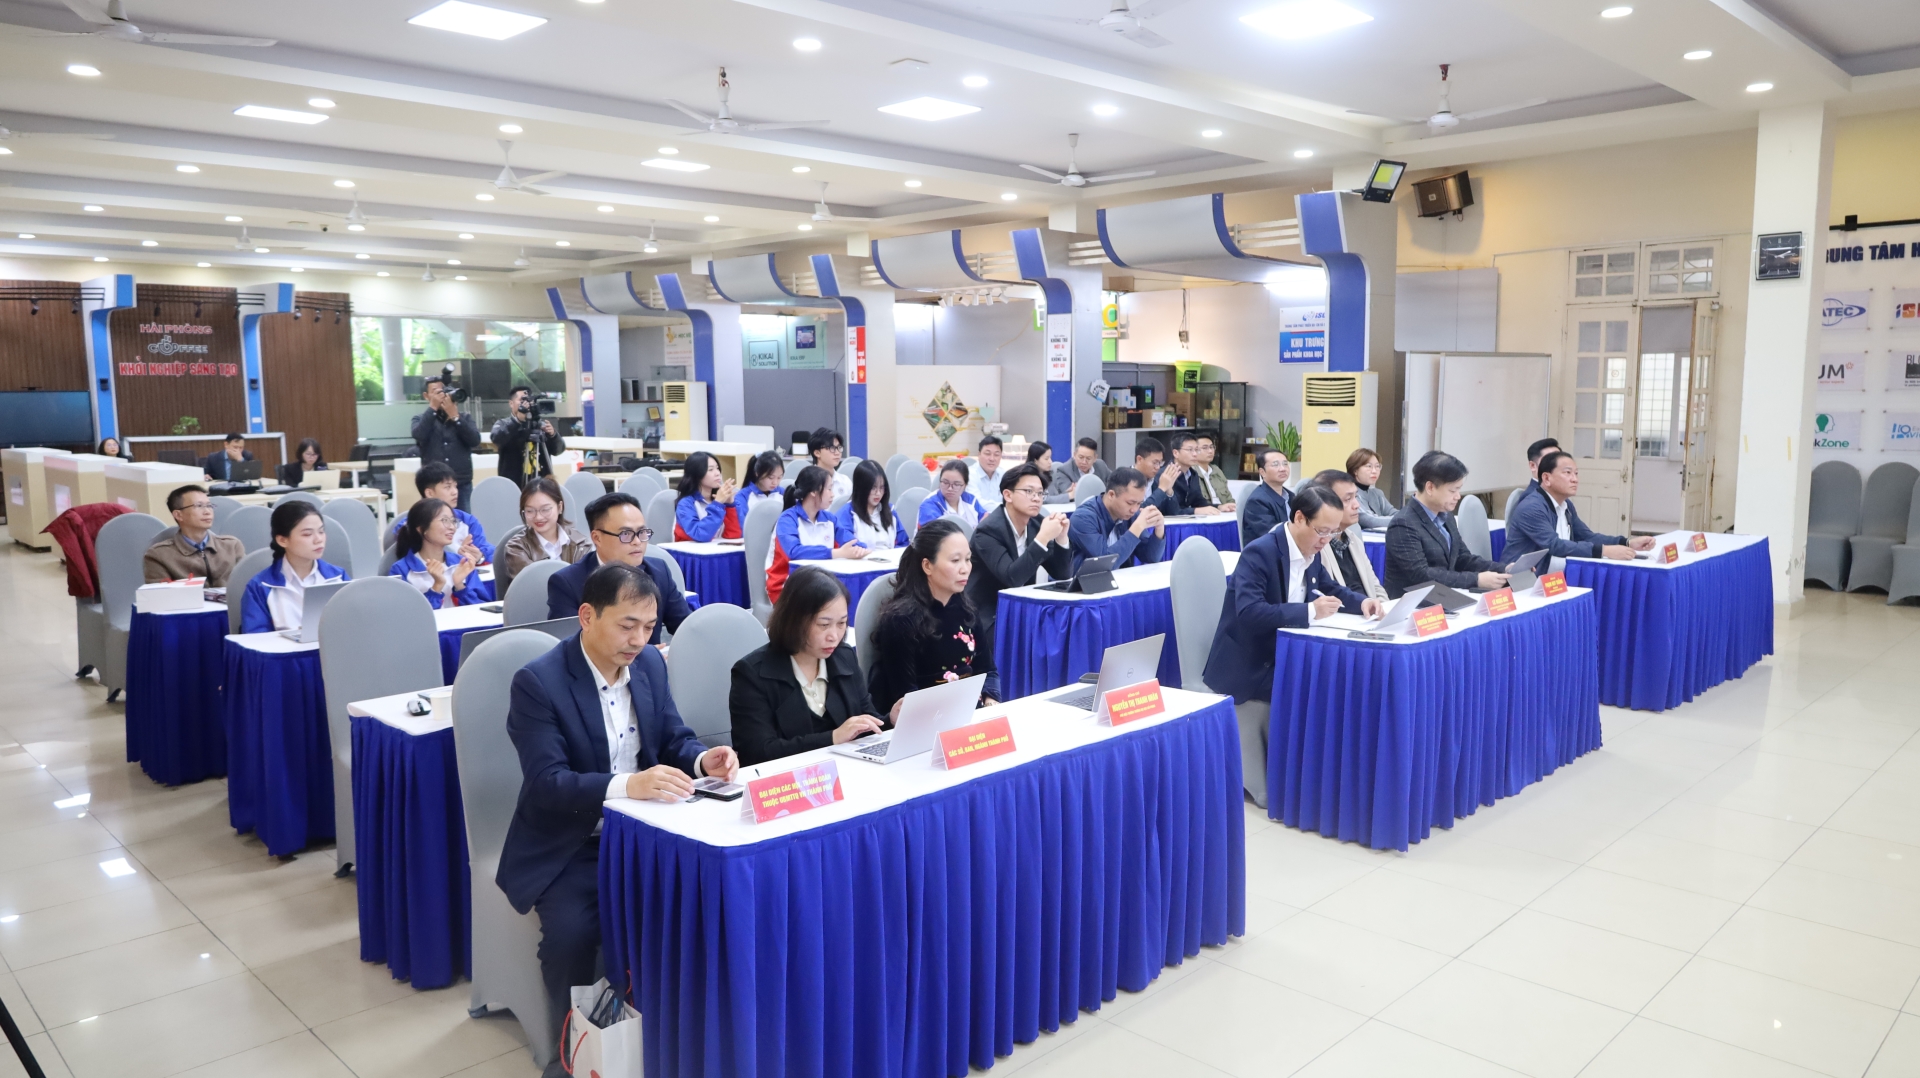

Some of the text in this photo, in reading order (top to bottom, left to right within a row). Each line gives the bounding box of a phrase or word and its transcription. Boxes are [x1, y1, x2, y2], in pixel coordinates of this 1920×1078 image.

[1826, 246, 1863, 263] UNG
[1869, 241, 1905, 260] TÂM
[1291, 338, 1303, 348] KHU
[1906, 354, 1920, 364] BL
[149, 360, 187, 377] NGHIỆP
[190, 358, 216, 375] SÁNG
[218, 363, 238, 377] TẠO
[1814, 438, 1849, 447] kZone
[988, 738, 1001, 746] THÀNH
[1001, 734, 1009, 743] PHỐ
[769, 786, 781, 796] DIỆN
[781, 783, 791, 792] CÁC
[762, 798, 779, 808] THUỘC
[807, 786, 823, 796] THÀNH
